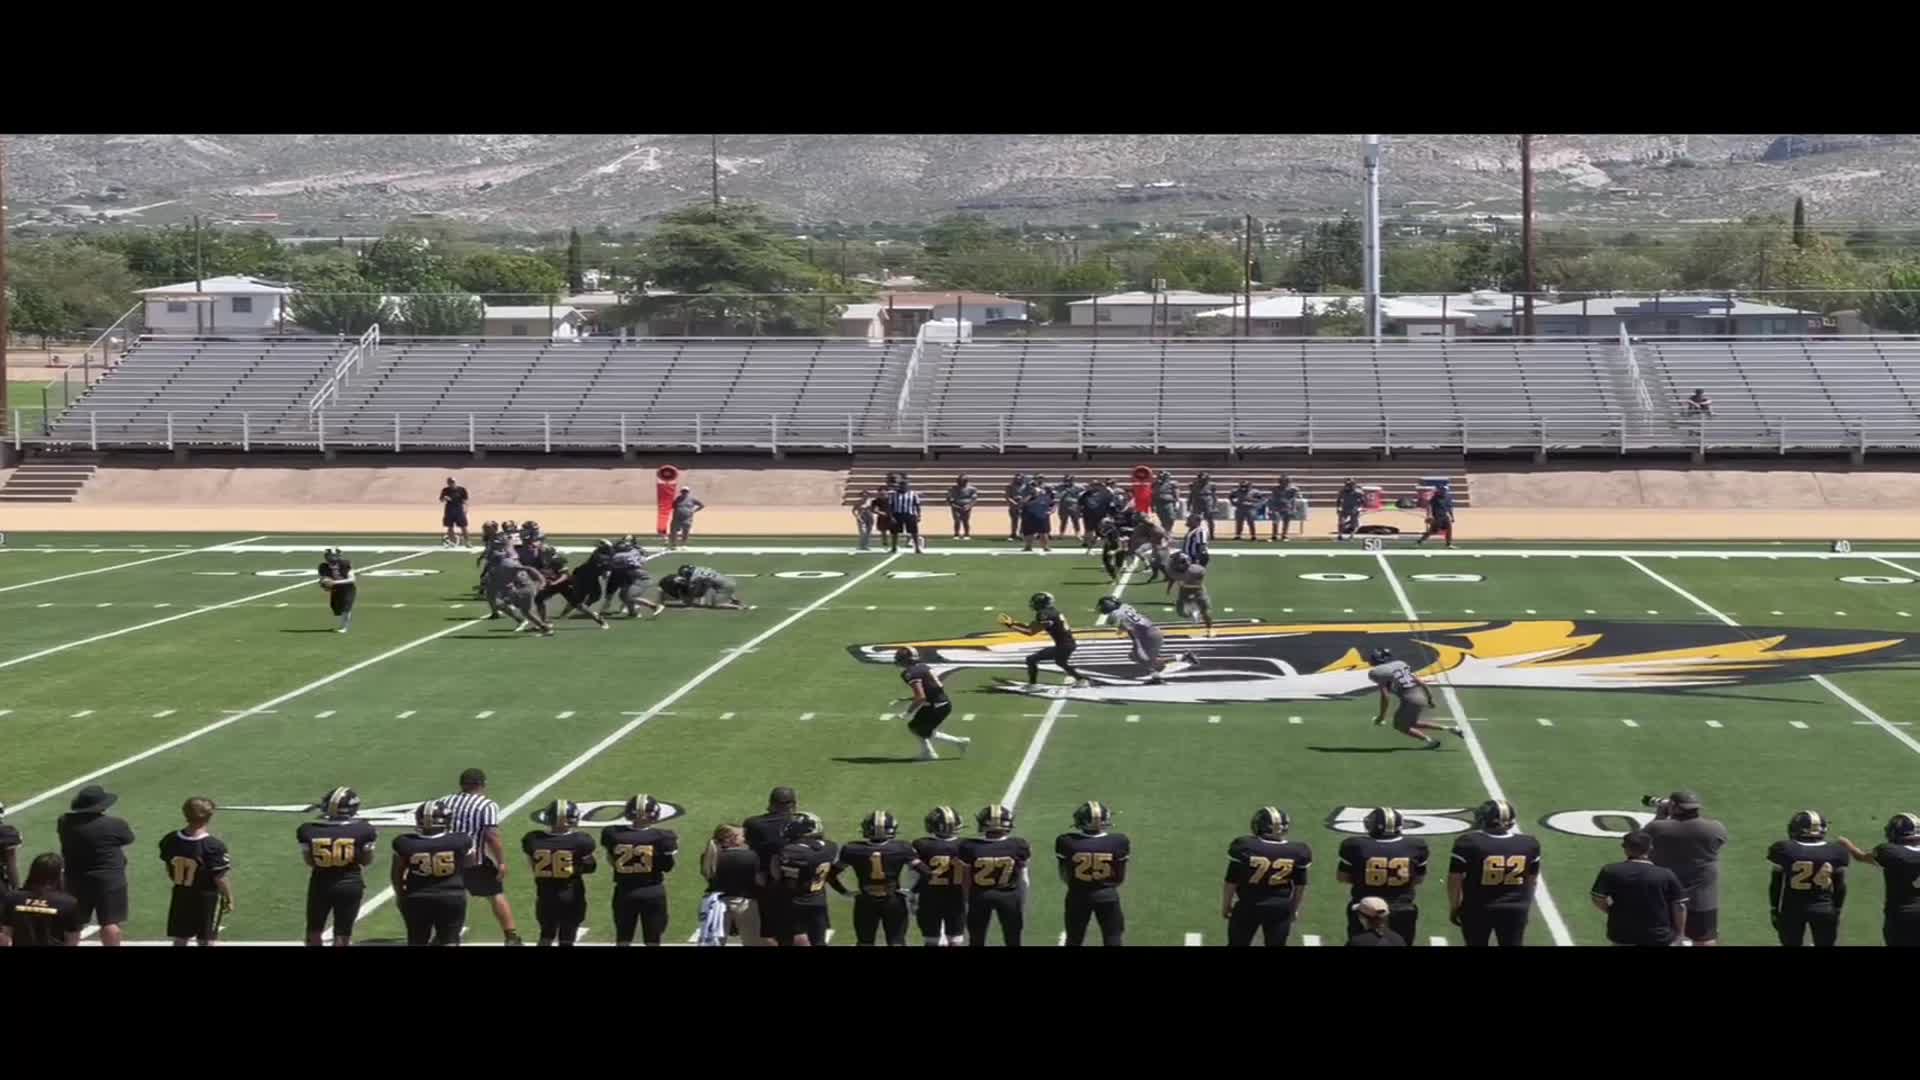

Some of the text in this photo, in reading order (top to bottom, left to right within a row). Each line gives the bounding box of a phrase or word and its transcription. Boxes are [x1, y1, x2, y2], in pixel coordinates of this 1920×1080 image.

[1364, 538, 1382, 551] 50
[311, 838, 356, 868] 50
[410, 851, 456, 878] 36
[534, 849, 574, 878] 26
[615, 844, 653, 873] 23
[870, 851, 886, 881] 1
[1072, 852, 1112, 881] 25
[974, 855, 1015, 887] 27
[1248, 855, 1295, 887] 72
[1365, 856, 1410, 887] 63
[1481, 855, 1527, 886] 62
[1791, 860, 1834, 891] 24
